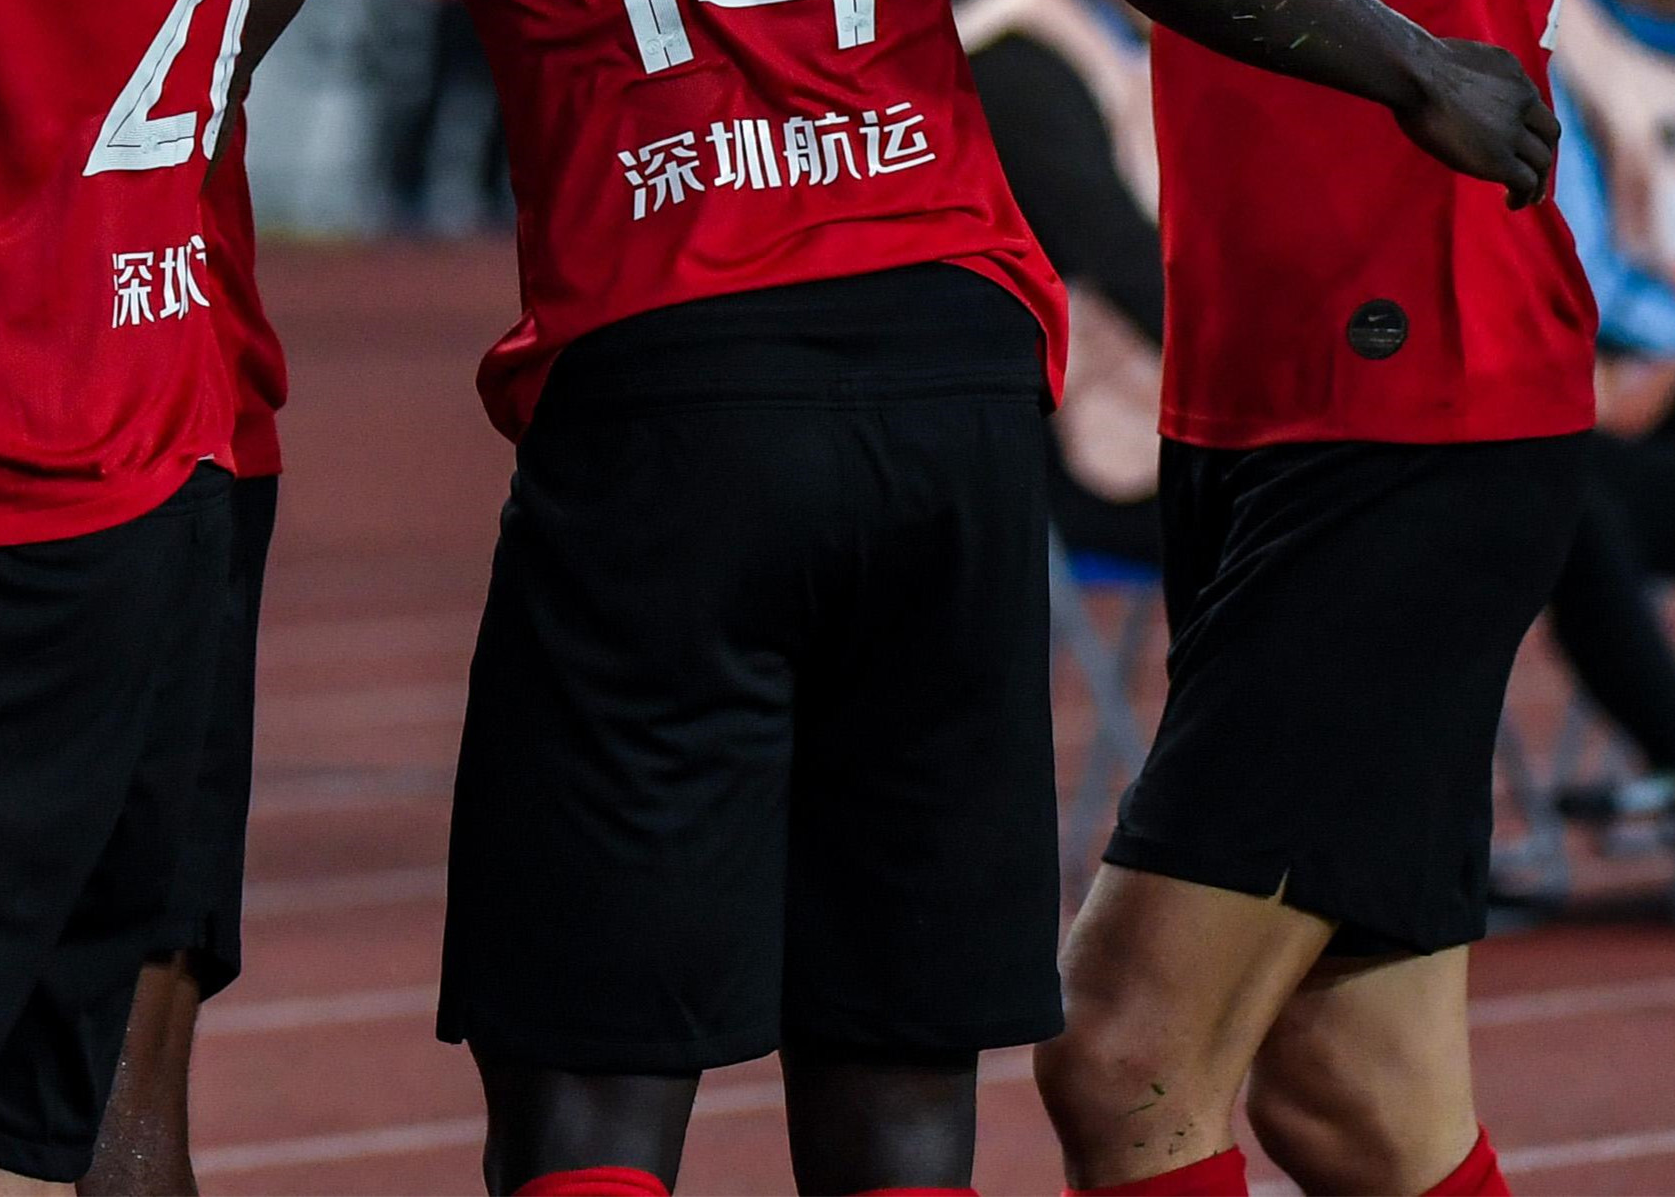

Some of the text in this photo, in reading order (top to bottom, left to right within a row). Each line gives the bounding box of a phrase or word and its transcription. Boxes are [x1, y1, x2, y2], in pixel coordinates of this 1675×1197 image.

[617, 101, 937, 221] 深圳航运
[112, 234, 211, 329] 深圳
